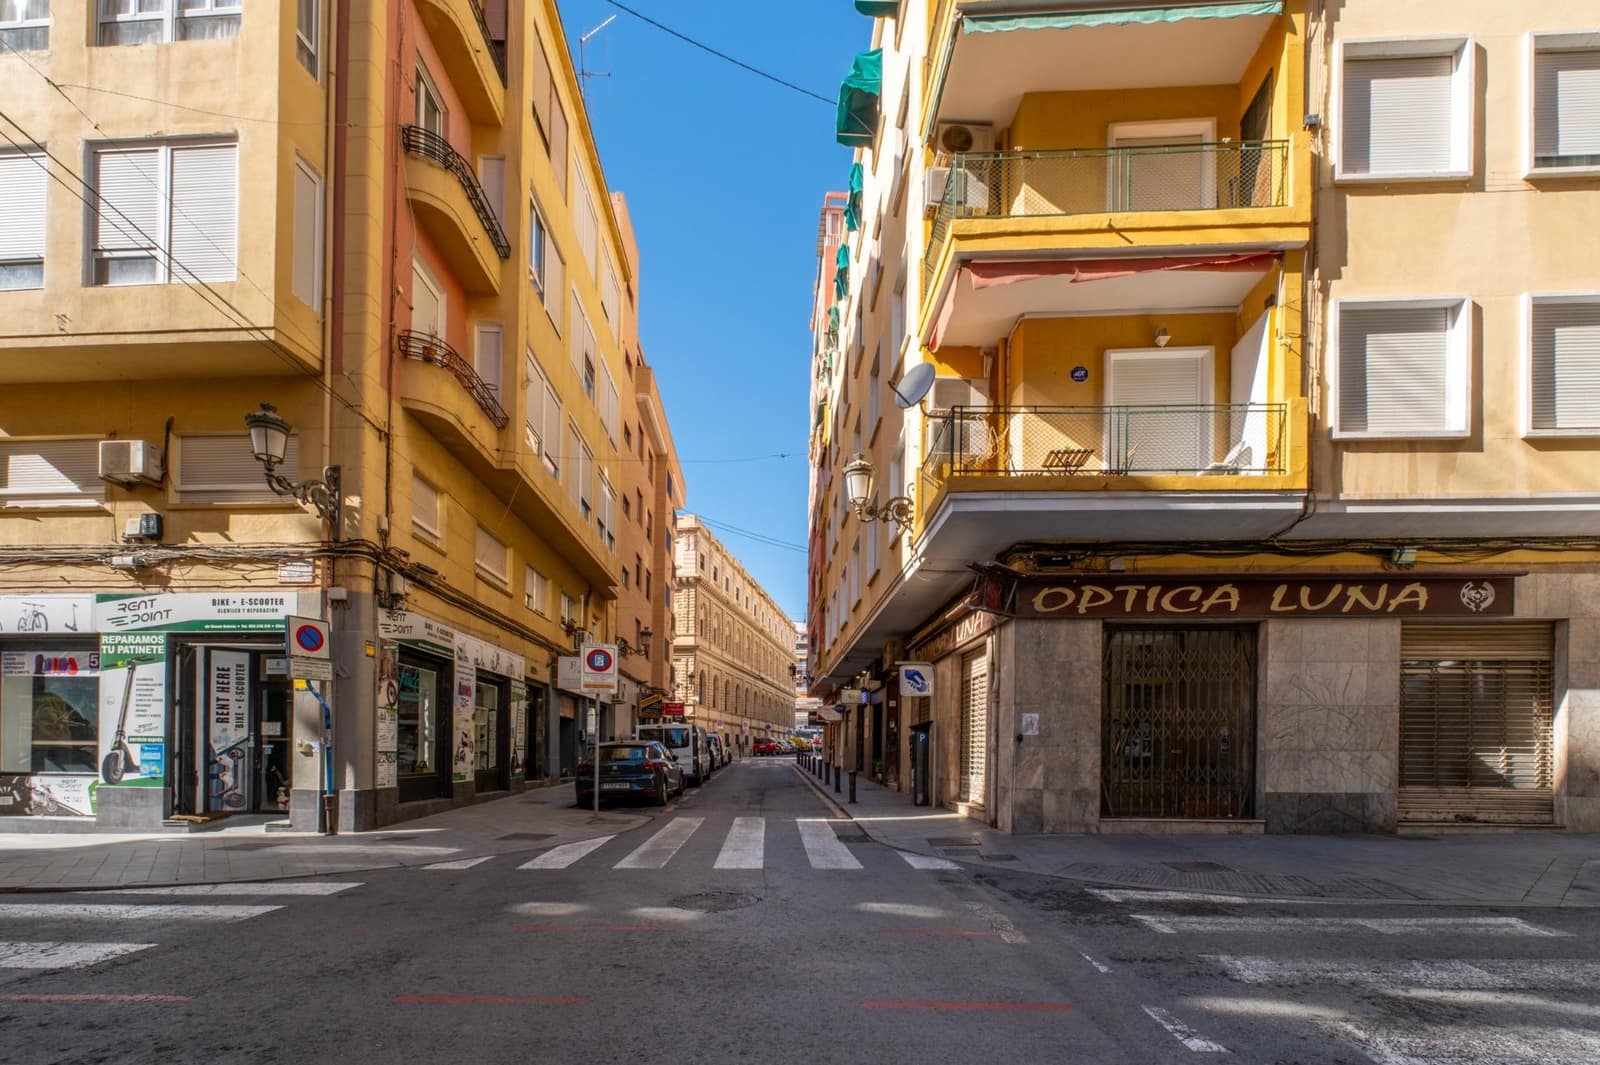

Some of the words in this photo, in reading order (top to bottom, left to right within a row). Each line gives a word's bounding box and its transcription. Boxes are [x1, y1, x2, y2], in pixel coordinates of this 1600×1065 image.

[117, 598, 157, 613] RENT
[211, 598, 230, 607] BIKE
[240, 598, 285, 606] E-SCOOTER
[1031, 583, 1241, 615] OPTICA
[1270, 582, 1429, 613] LUNA
[130, 609, 173, 625] POINT
[385, 611, 407, 623] RENT
[102, 635, 165, 644] REPARAMOS
[102, 646, 115, 655] TU
[117, 646, 165, 655] PATINETE
[216, 666, 230, 693] HERE
[235, 663, 245, 702] E-SCOOTER
[216, 696, 230, 723] RENT
[235, 712, 244, 728] BIKE
